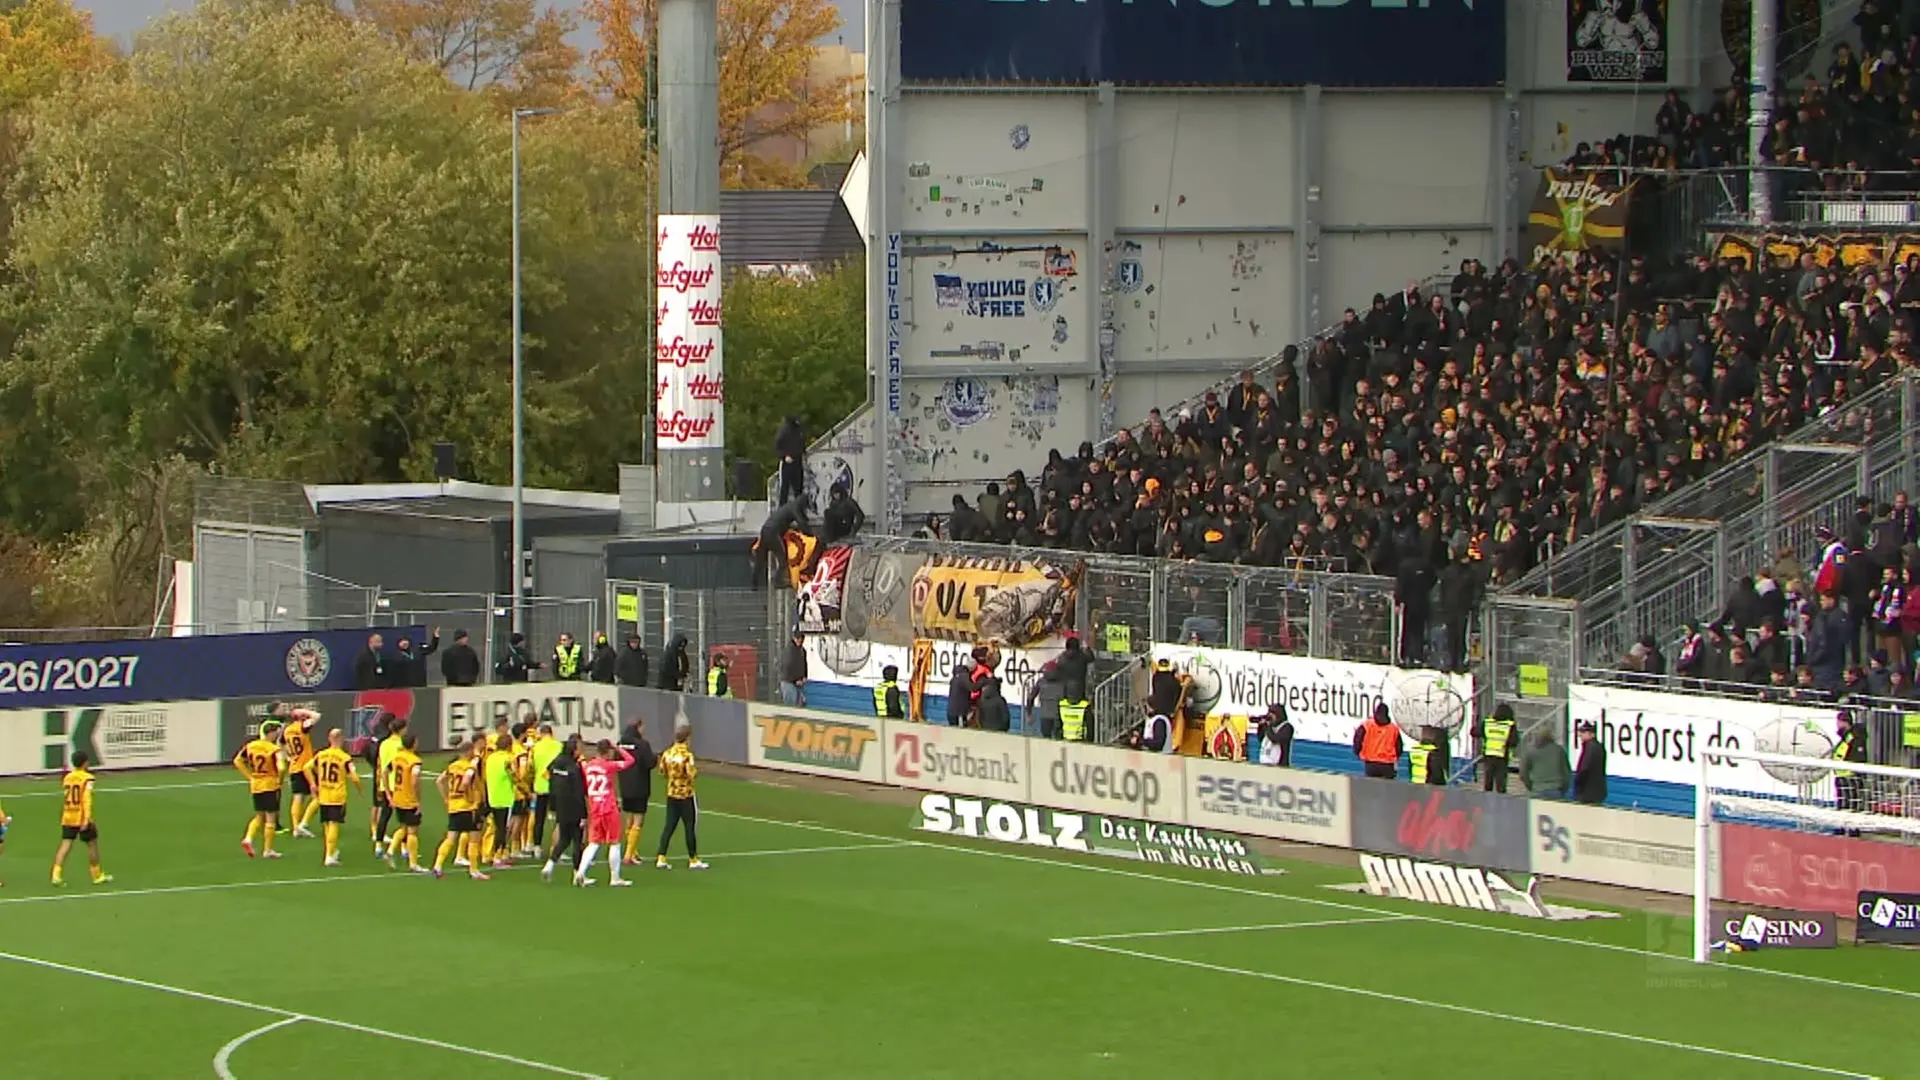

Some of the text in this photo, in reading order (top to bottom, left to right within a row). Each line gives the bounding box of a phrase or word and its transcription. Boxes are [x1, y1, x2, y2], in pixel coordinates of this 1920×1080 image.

[967, 280, 1025, 297] YOUNG
[322, 762, 339, 782] 16
[924, 742, 1018, 784] Sydbank
[64, 785, 80, 806] 20
[586, 774, 609, 796] 22
[1196, 774, 1336, 815] PSCHORN
[921, 793, 1089, 850] STOLZ
[1101, 818, 1246, 856] Das Kaufhaus
[1136, 842, 1256, 876] im Norden
[1359, 853, 1497, 911] PUMA
[1725, 917, 1823, 938] CASINO
